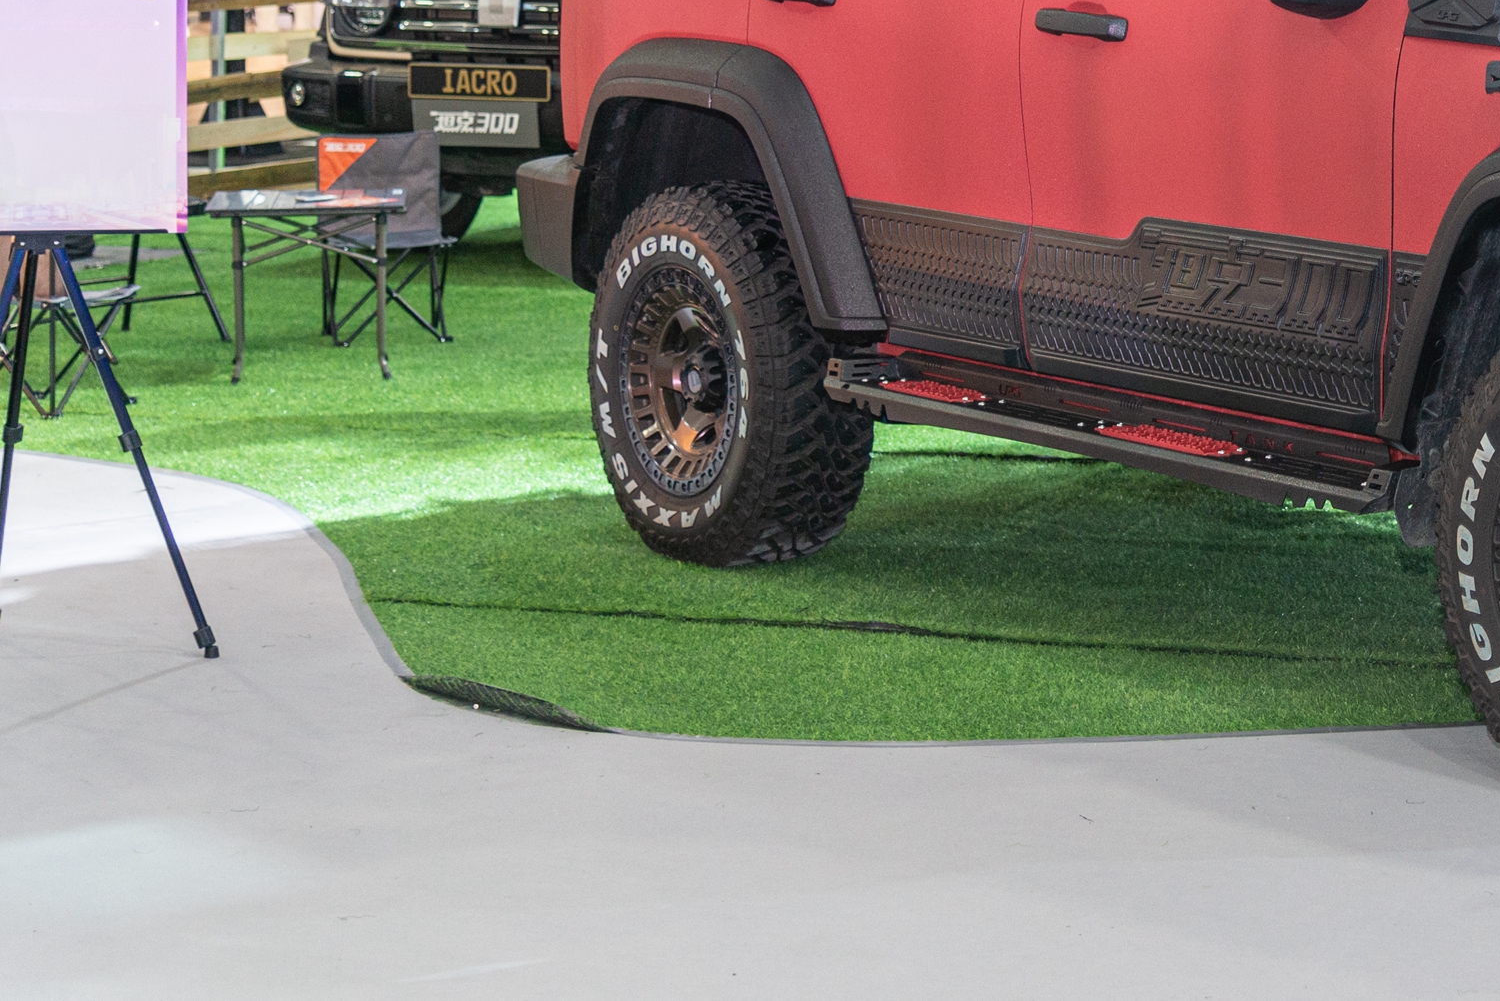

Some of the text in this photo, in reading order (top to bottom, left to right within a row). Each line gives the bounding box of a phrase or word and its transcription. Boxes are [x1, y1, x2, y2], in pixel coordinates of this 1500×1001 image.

[442, 69, 517, 96] IACRO
[430, 110, 520, 135] 坦克300
[616, 234, 731, 308] BIGHORN
[611, 452, 723, 528] MAXXIS
